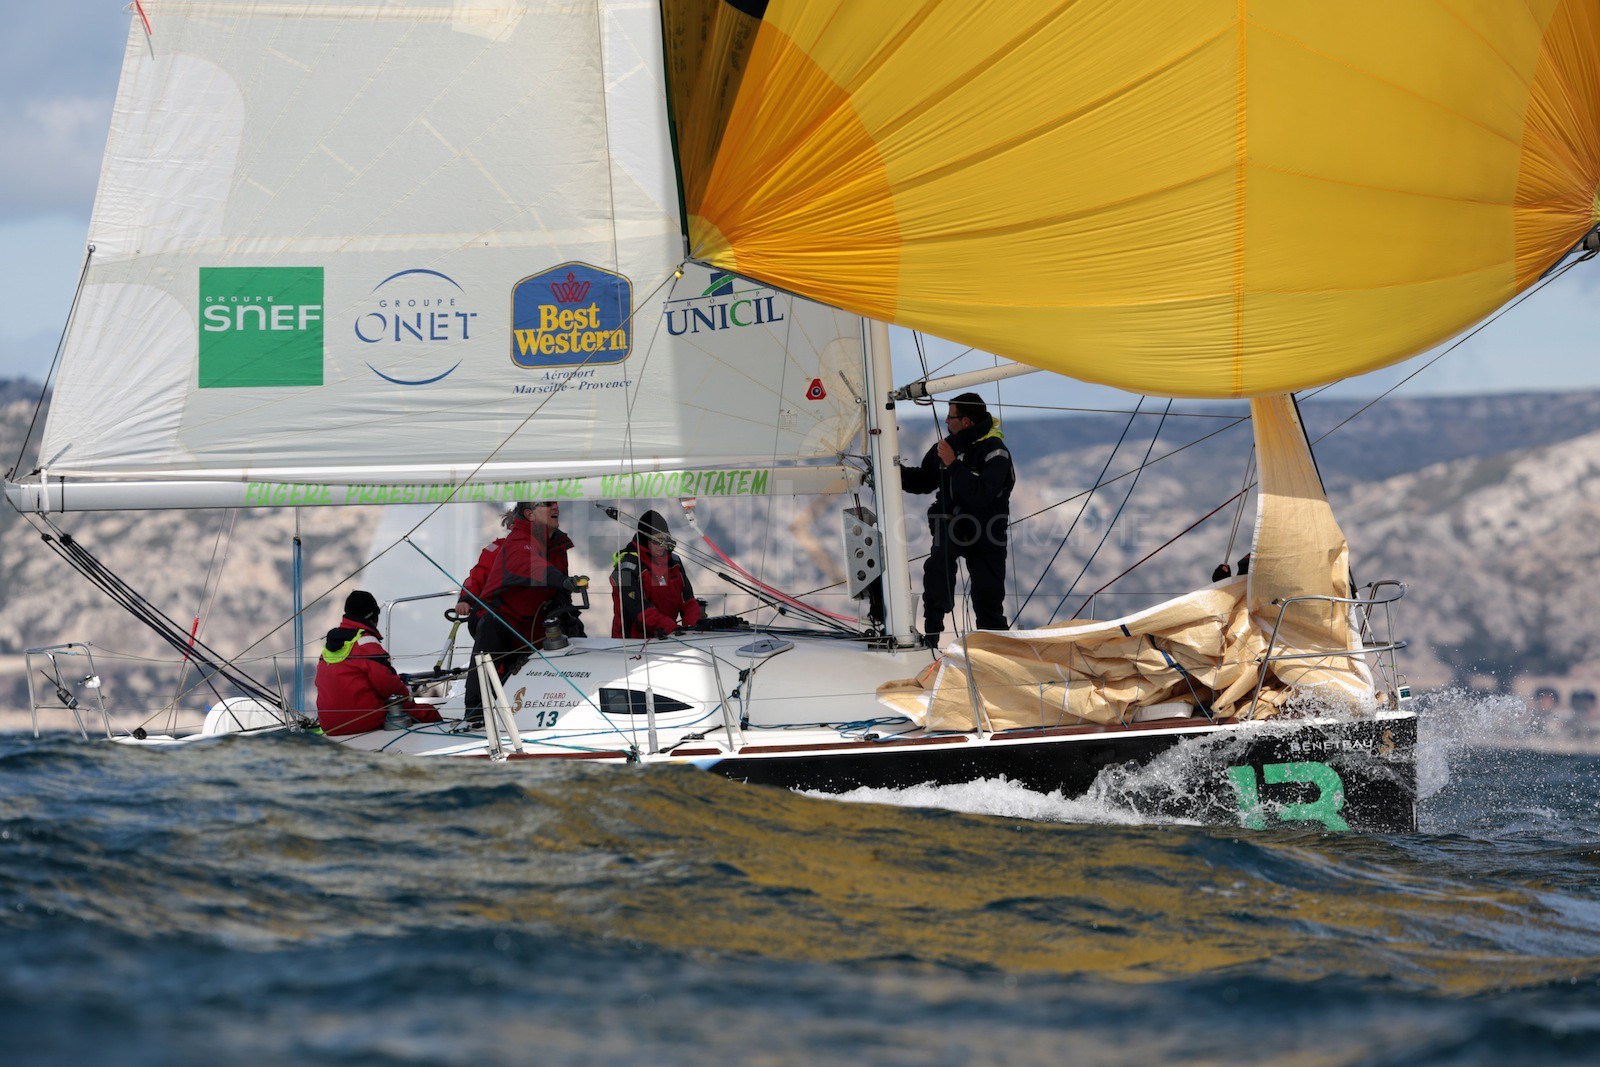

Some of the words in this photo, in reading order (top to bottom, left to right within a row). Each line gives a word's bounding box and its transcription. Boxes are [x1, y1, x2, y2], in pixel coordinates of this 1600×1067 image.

[379, 298, 456, 308] GROUPE
[354, 312, 478, 343] ONET
[538, 302, 600, 332] Best
[663, 296, 784, 336] UNICIL
[514, 327, 628, 356] Western
[541, 368, 596, 381] Aéroport
[512, 382, 568, 395] Marseille
[578, 379, 632, 391] Provence
[243, 482, 333, 506] FUGERE
[600, 469, 769, 499] MEDIOCRITATEM
[543, 692, 567, 700] FIGARO
[536, 711, 559, 728] 13
